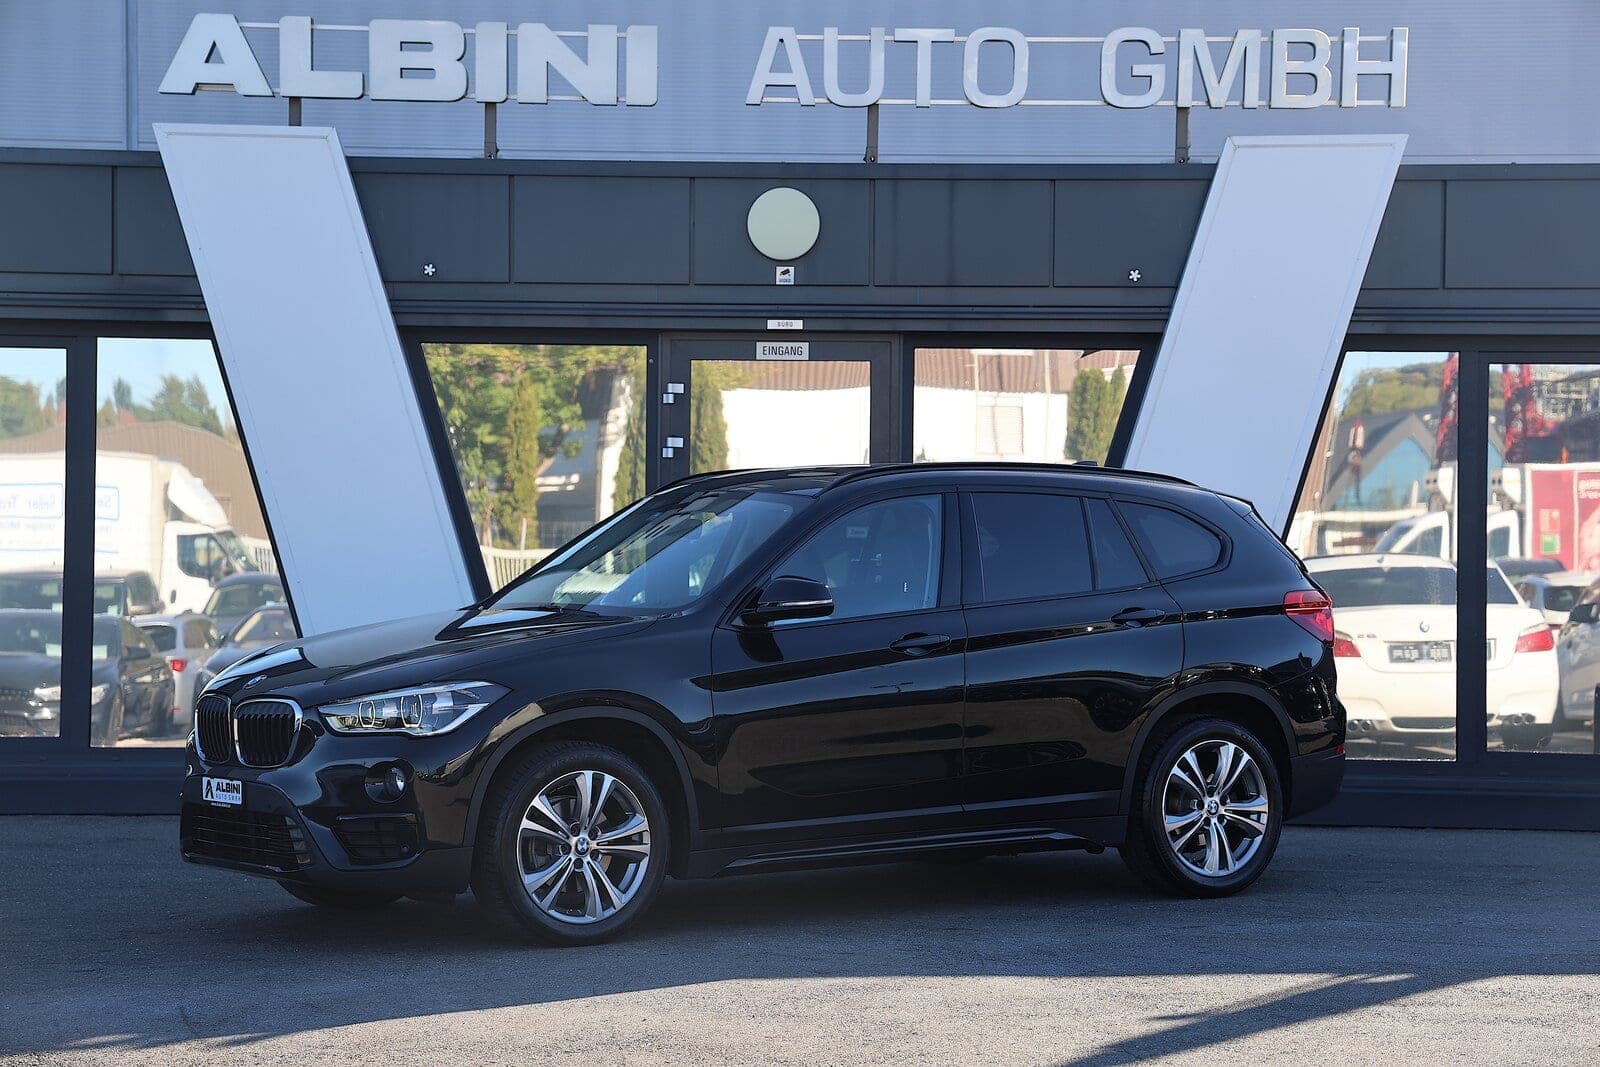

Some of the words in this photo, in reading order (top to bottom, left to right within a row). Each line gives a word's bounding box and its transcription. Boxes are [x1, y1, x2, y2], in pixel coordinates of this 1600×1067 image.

[158, 13, 659, 107] ALBINI
[745, 26, 1030, 108] AUTO
[1100, 26, 1410, 110] GMBH
[762, 345, 803, 356] EINGANG
[216, 782, 240, 795] ALBINI
